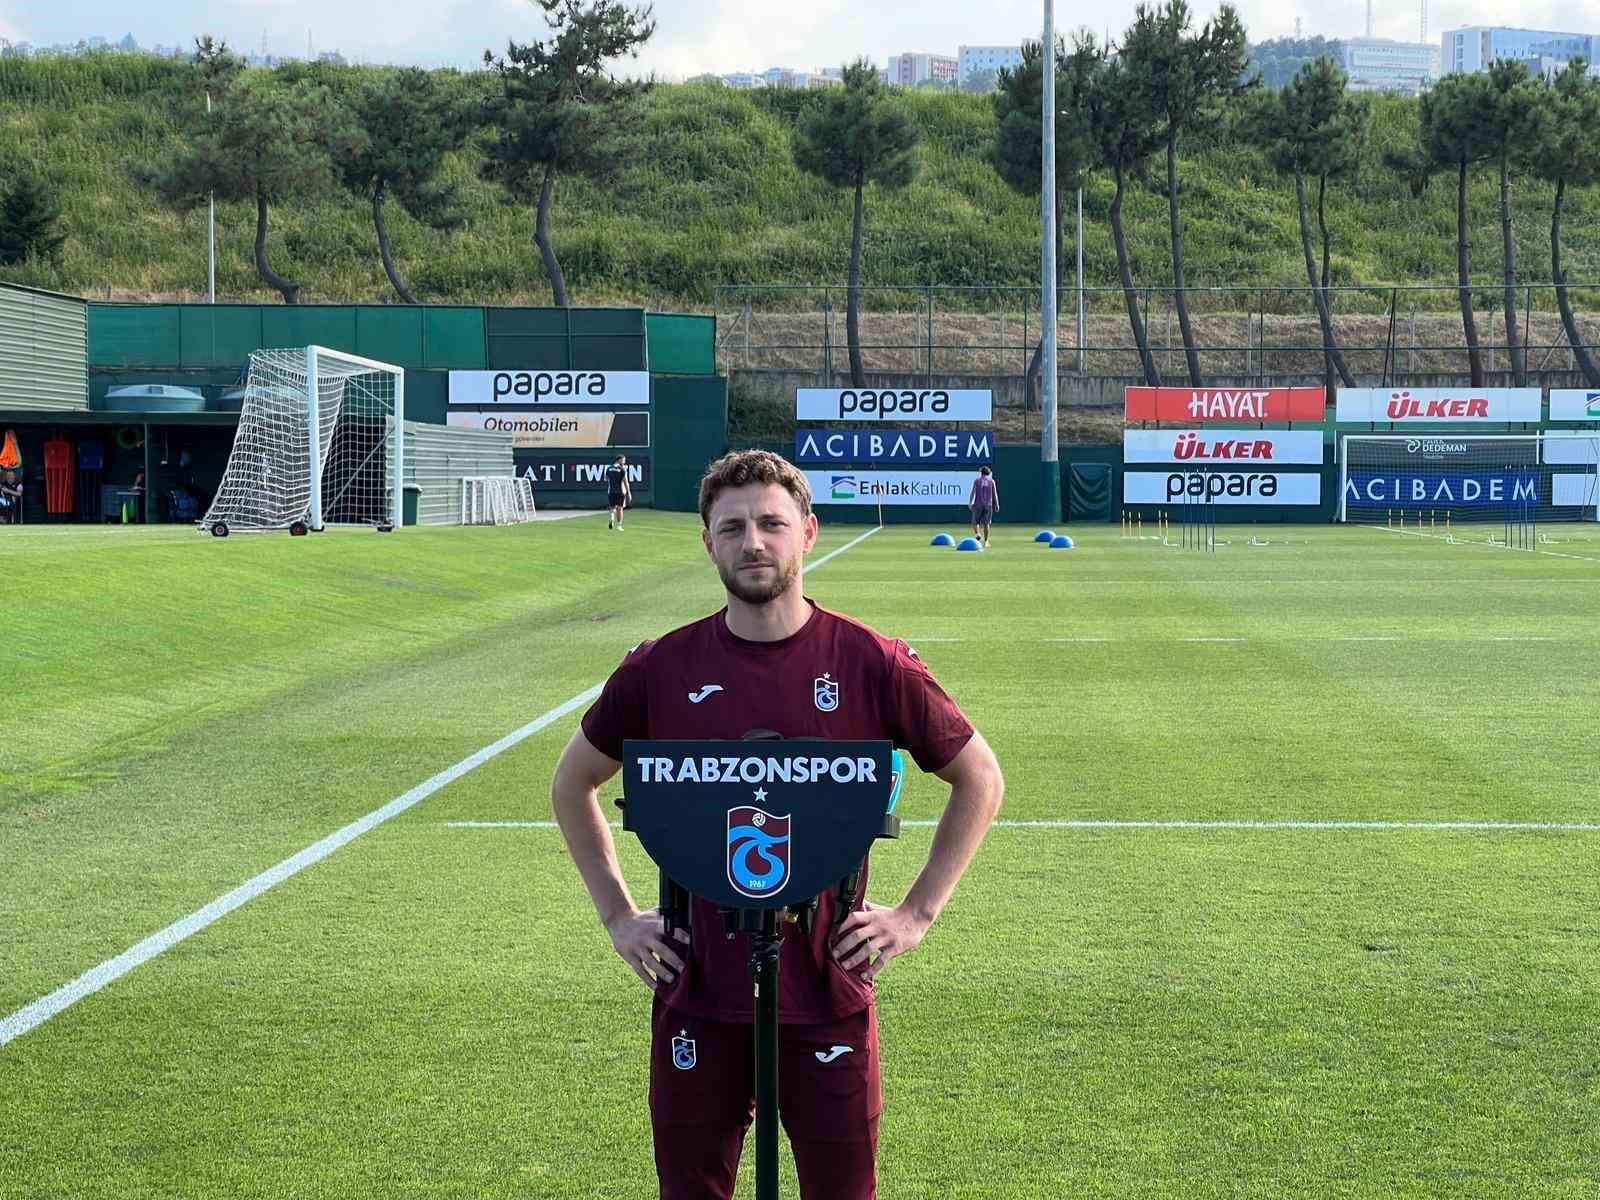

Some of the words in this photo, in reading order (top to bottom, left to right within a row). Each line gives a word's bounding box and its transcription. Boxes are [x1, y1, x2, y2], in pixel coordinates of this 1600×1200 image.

[493, 372, 606, 401] papara
[839, 390, 949, 419] papara
[1188, 391, 1269, 418] HAYAT
[1387, 391, 1488, 418] ÜLKER
[484, 417, 578, 432] Otomobilen
[799, 434, 990, 458] ACIBADEM
[1173, 432, 1273, 460] ÜLKER
[1166, 473, 1278, 502] papara
[637, 756, 877, 783] TRABZONSPOR
